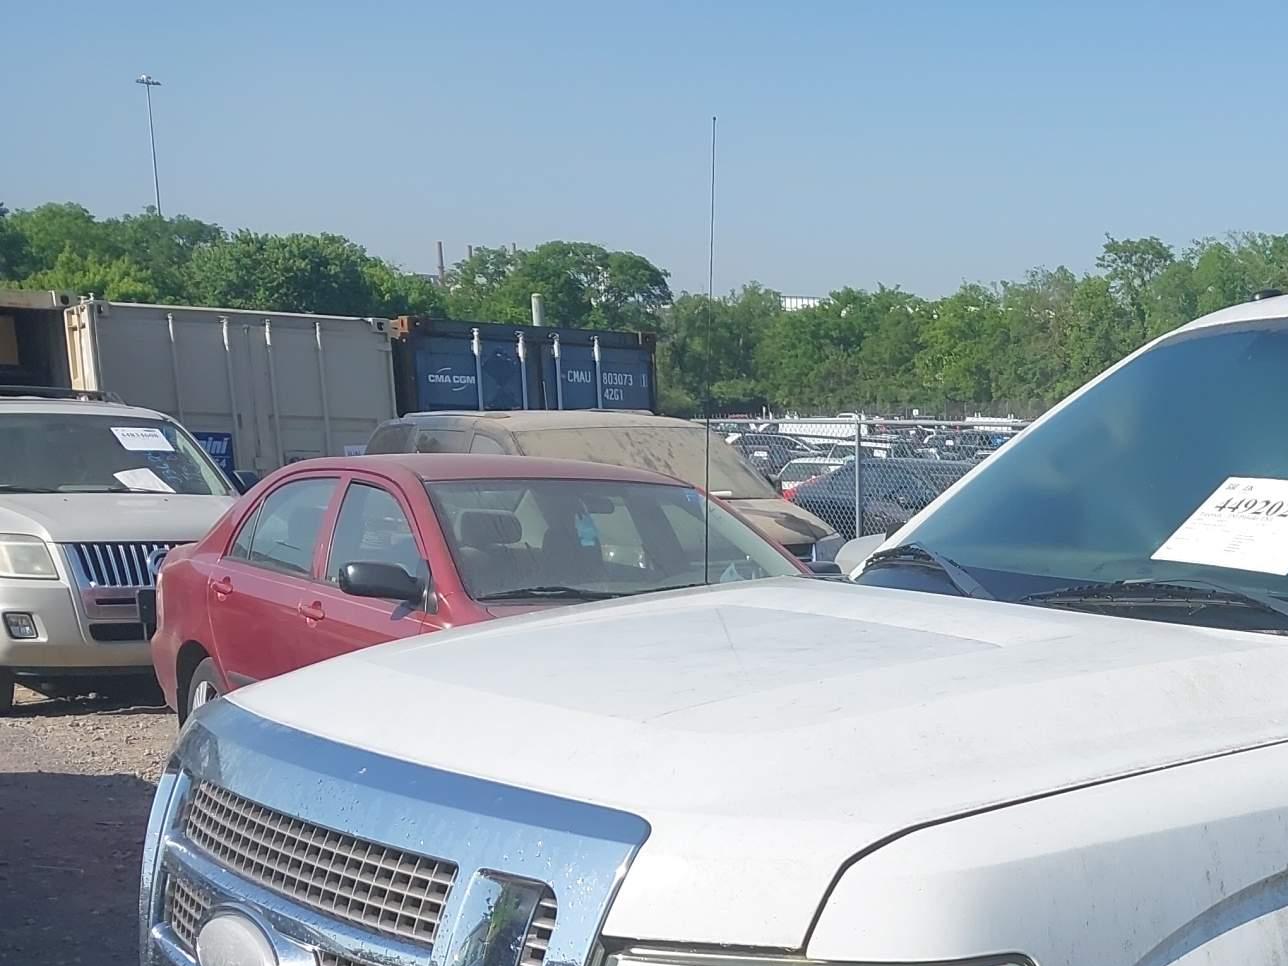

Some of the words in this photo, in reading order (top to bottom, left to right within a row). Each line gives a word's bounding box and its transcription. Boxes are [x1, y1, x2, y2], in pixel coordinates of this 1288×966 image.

[427, 374, 452, 384] CMA
[452, 375, 476, 385] CGM
[567, 369, 592, 384] CMAU
[602, 372, 634, 387] 803073
[603, 387, 624, 401] 42G1
